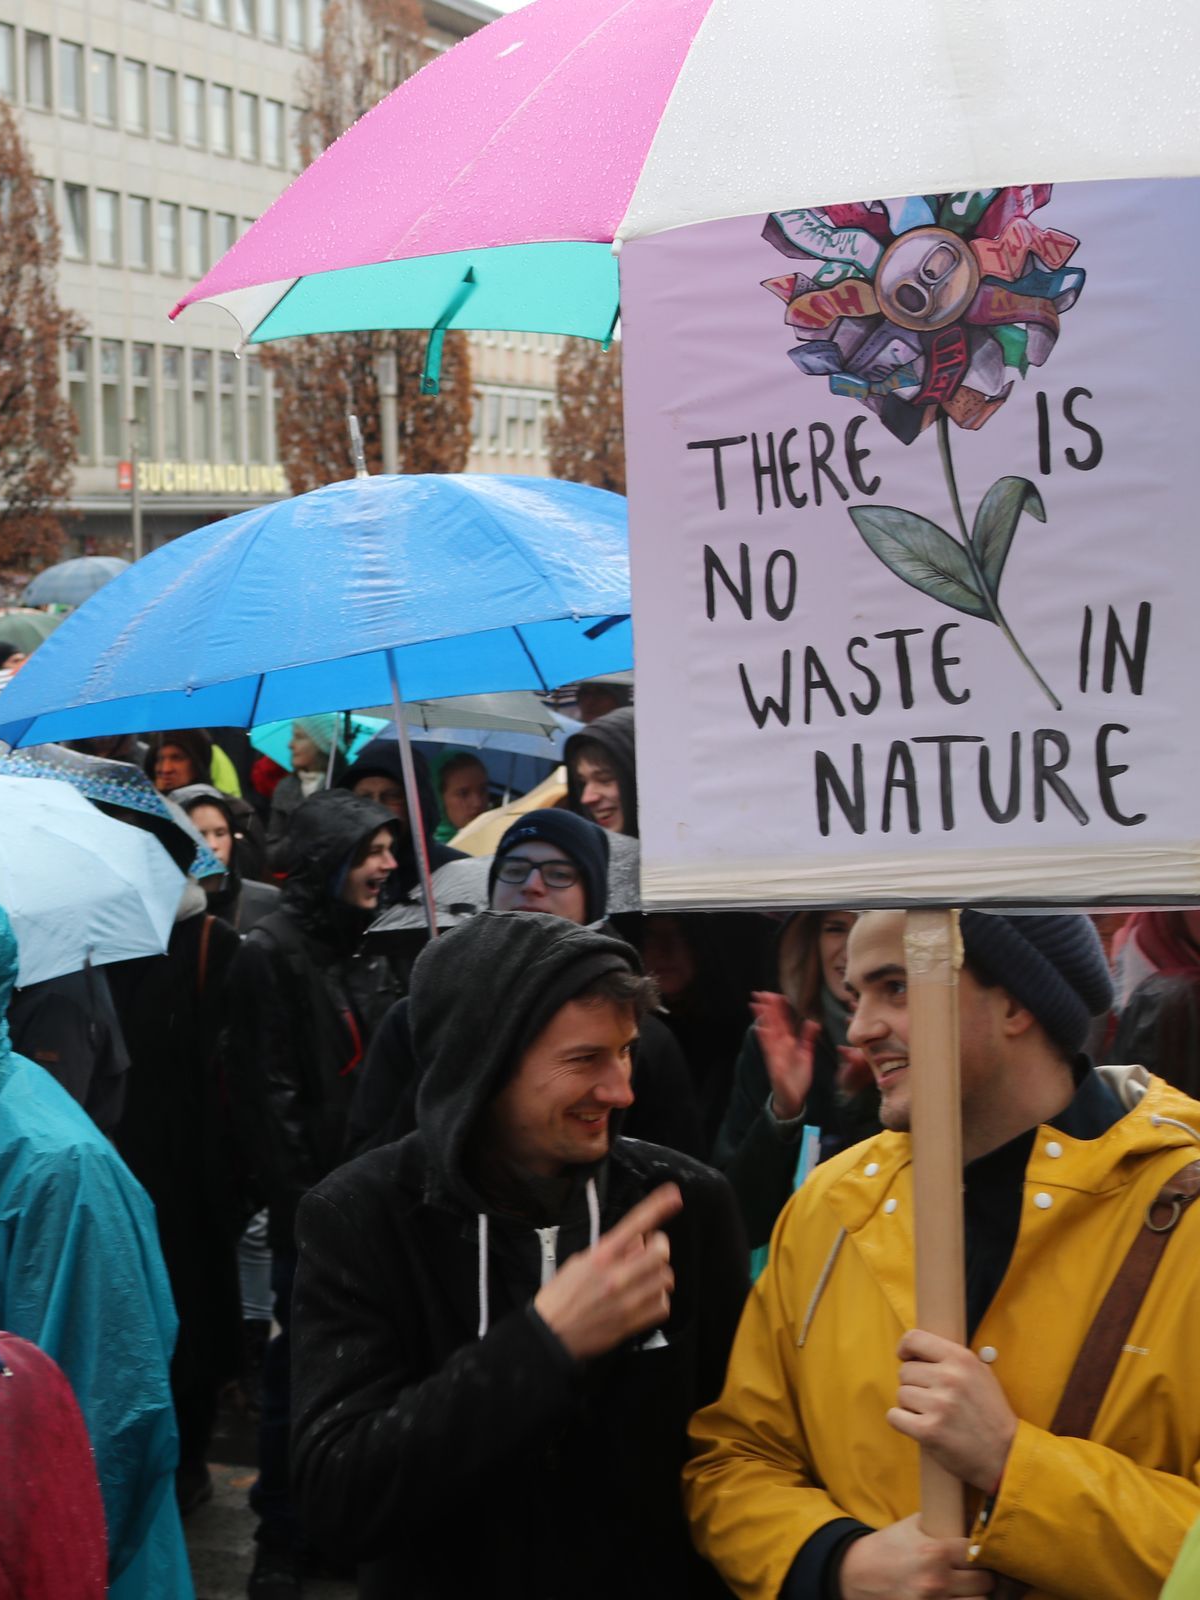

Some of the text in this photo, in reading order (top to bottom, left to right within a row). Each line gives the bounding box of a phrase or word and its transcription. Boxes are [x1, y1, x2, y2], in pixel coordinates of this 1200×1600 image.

[687, 387, 1103, 514] THERE IS
[704, 543, 797, 622] NO
[739, 602, 1152, 729] WASTE IN
[815, 724, 1147, 837] NATURE
